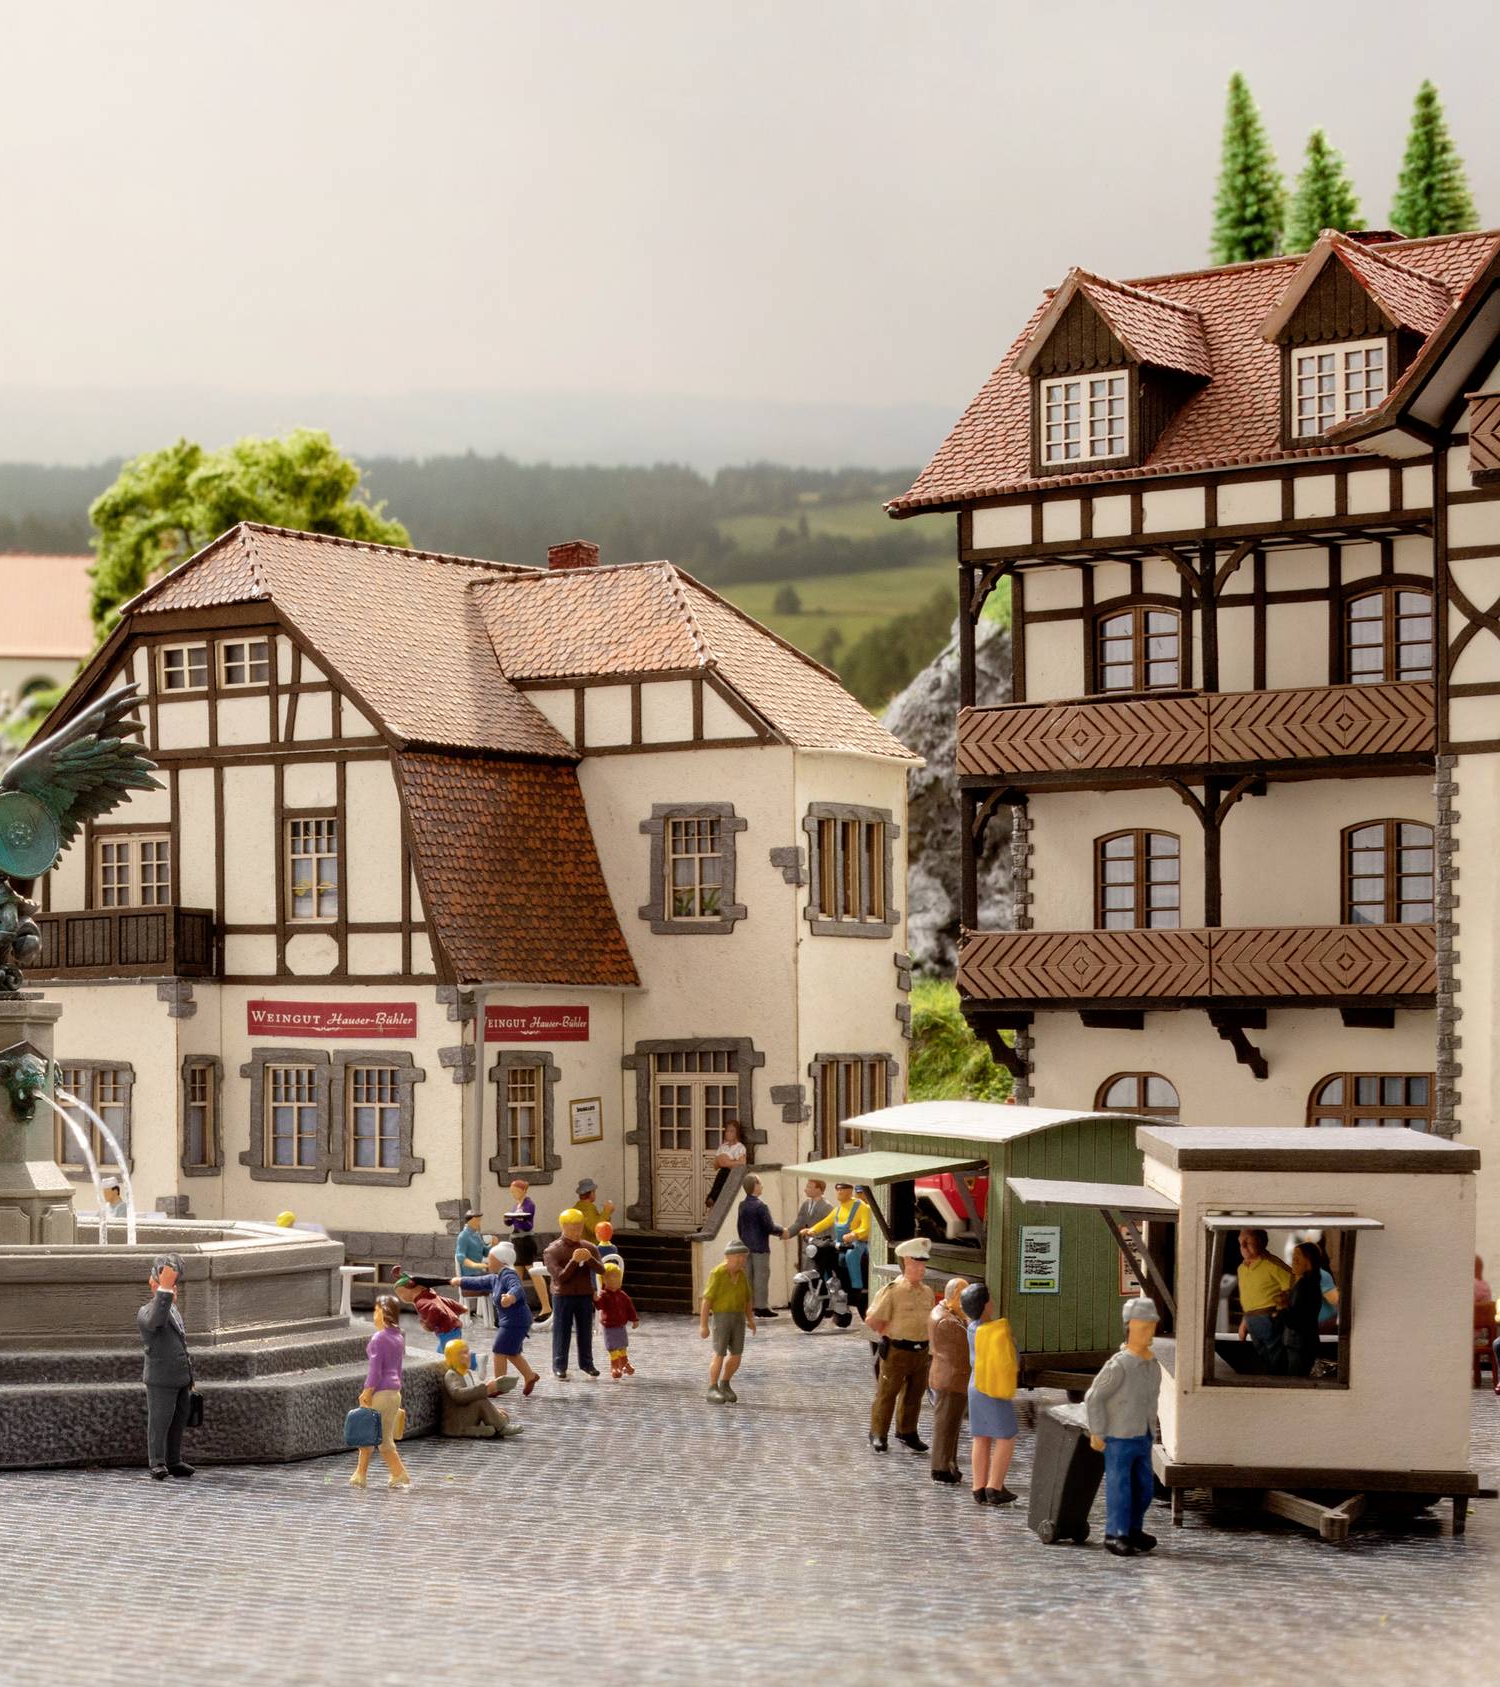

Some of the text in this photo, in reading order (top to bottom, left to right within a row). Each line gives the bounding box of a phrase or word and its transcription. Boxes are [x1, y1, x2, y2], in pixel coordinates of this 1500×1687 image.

[251, 1010, 413, 1025] WEINGUT Hauser-Bühler
[484, 1016, 527, 1028] EINGUT
